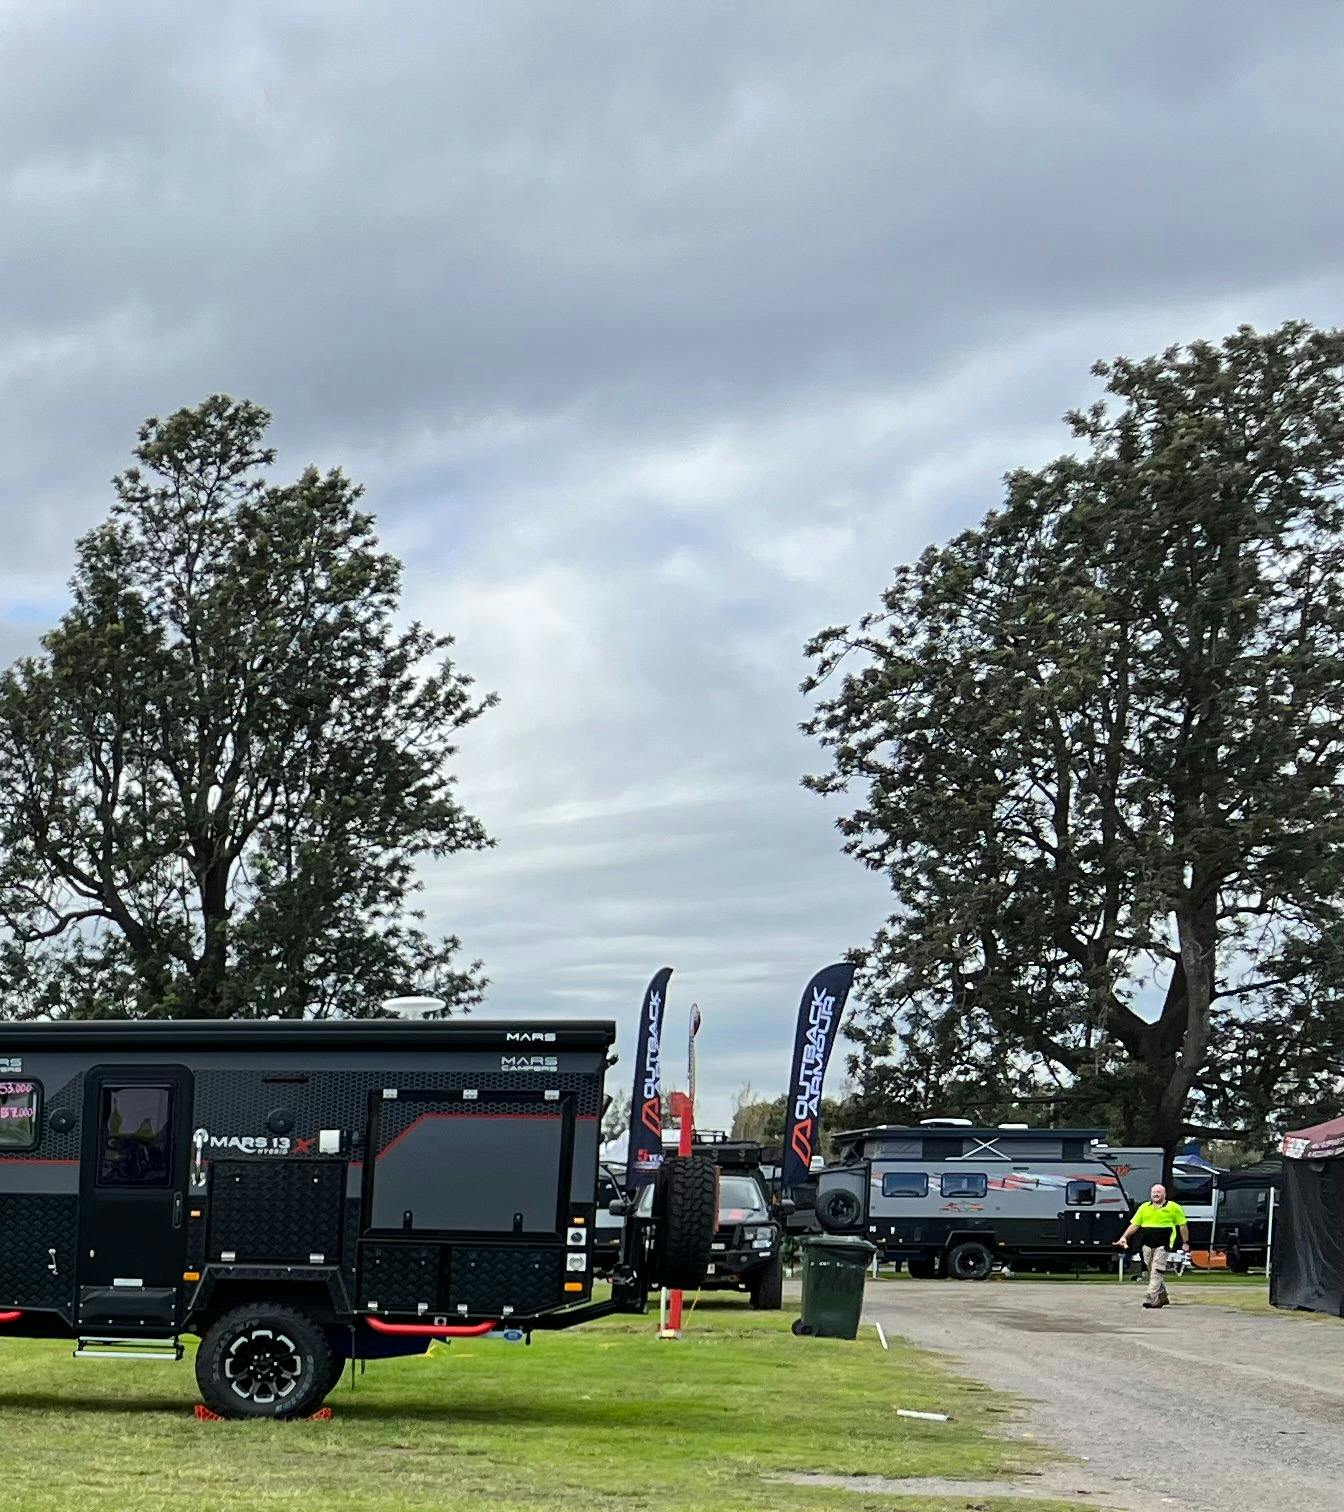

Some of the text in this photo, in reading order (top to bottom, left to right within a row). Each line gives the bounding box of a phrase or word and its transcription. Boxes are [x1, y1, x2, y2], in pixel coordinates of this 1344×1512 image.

[501, 1056, 558, 1066] MARS
[506, 1032, 556, 1042] MARS
[643, 989, 662, 1099] OUTBACK
[794, 986, 827, 1120] OUTBACK
[808, 996, 836, 1118] ARMOUR
[209, 1136, 268, 1154] MARS
[272, 1137, 291, 1149] 13
